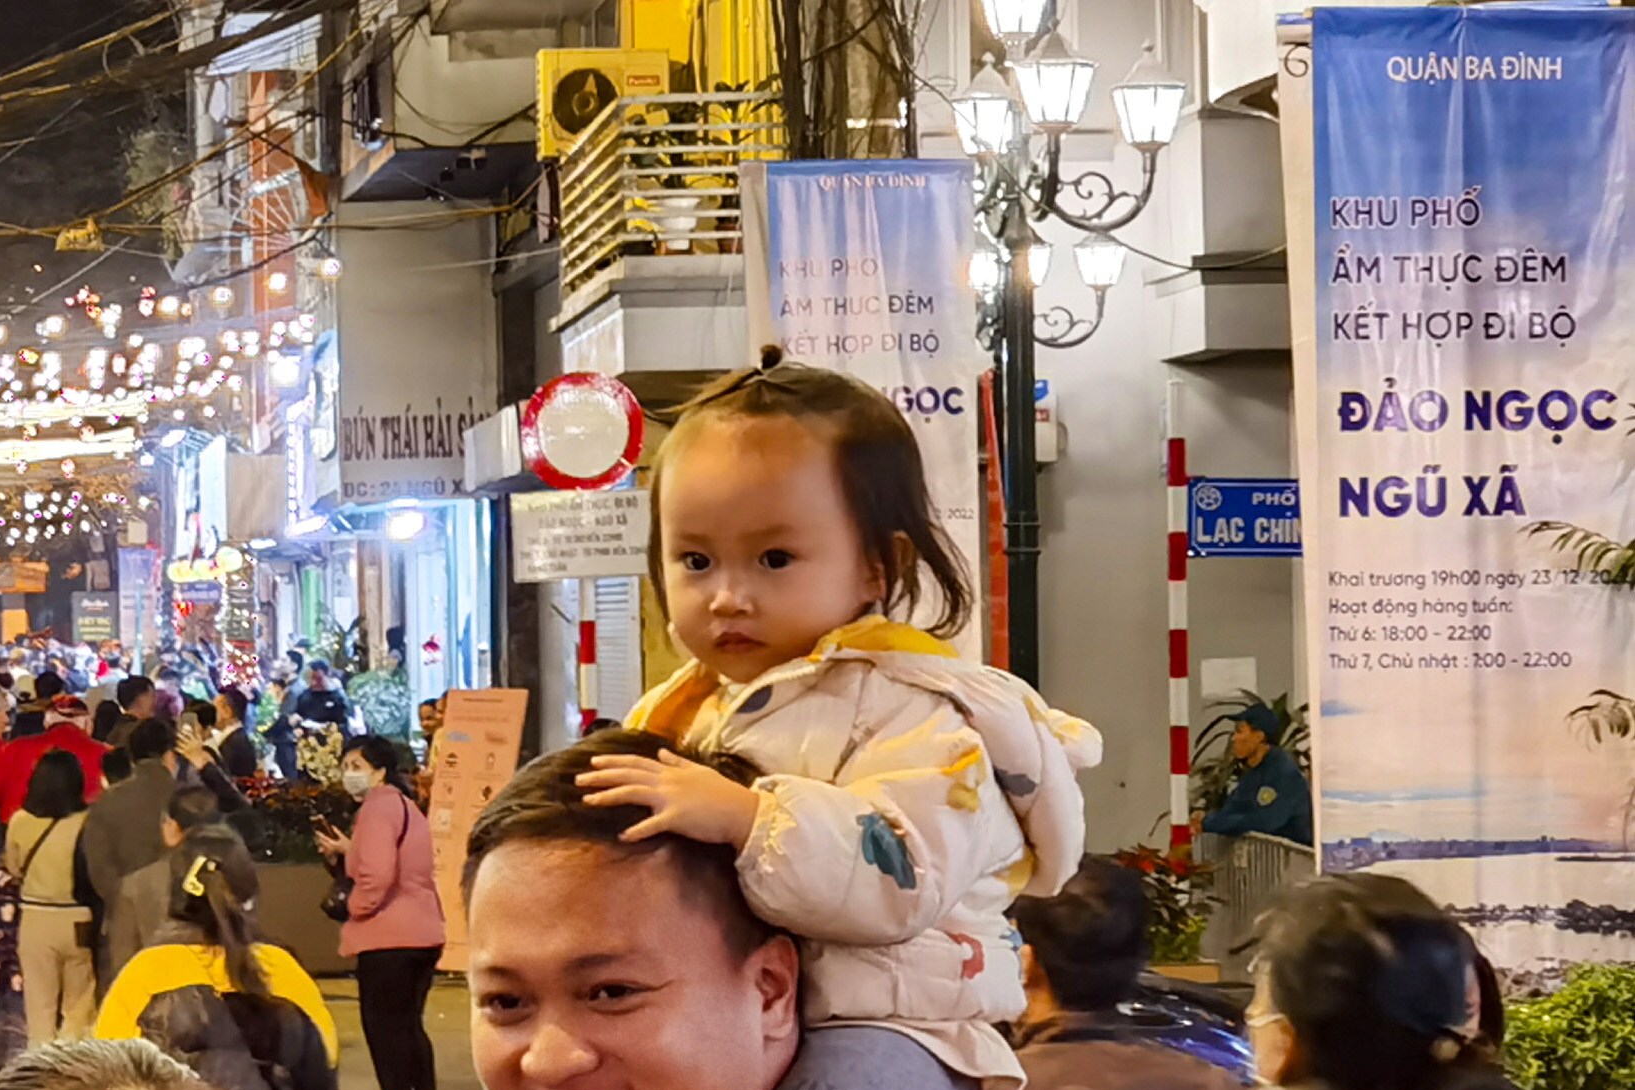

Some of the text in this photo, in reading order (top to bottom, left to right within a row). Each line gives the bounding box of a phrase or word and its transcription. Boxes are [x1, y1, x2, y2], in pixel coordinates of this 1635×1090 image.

[1386, 51, 1563, 85] QUẬN BA ĐÌNH
[1331, 185, 1482, 228] KHU PHỐ
[1332, 243, 1567, 291] ẨM THỰC ĐÊM
[888, 289, 934, 314] ĐÊM
[1333, 299, 1576, 348] KẾT HỢP ĐI BỘ
[881, 333, 903, 351] ĐI
[909, 329, 940, 358] BỘ
[882, 386, 965, 423] GỌC
[1337, 377, 1618, 445] ĐẢO NGỌC
[342, 405, 376, 461] BÚN
[380, 403, 420, 460] THÁI
[423, 397, 453, 458] HẢI
[1252, 483, 1297, 506] PHỐ
[1338, 464, 1528, 518] NGŨ XÃ
[1196, 511, 1302, 547] LẠC CHÍN
[1328, 571, 1365, 587] Khai
[1369, 573, 1426, 590] trương
[1431, 569, 1481, 586] 19h00
[1485, 569, 1526, 590] ngày
[1328, 598, 1367, 618] Hoạt
[1372, 598, 1417, 618] động
[1422, 598, 1468, 618] hàng
[1328, 625, 1358, 641] Thứ
[1381, 625, 1428, 641] 18:00
[1447, 625, 1491, 641] 22:00
[1328, 652, 1358, 669] Thứ
[1377, 651, 1413, 669] Chủ
[1418, 653, 1458, 673] nhật
[1523, 652, 1572, 668] 22:00
